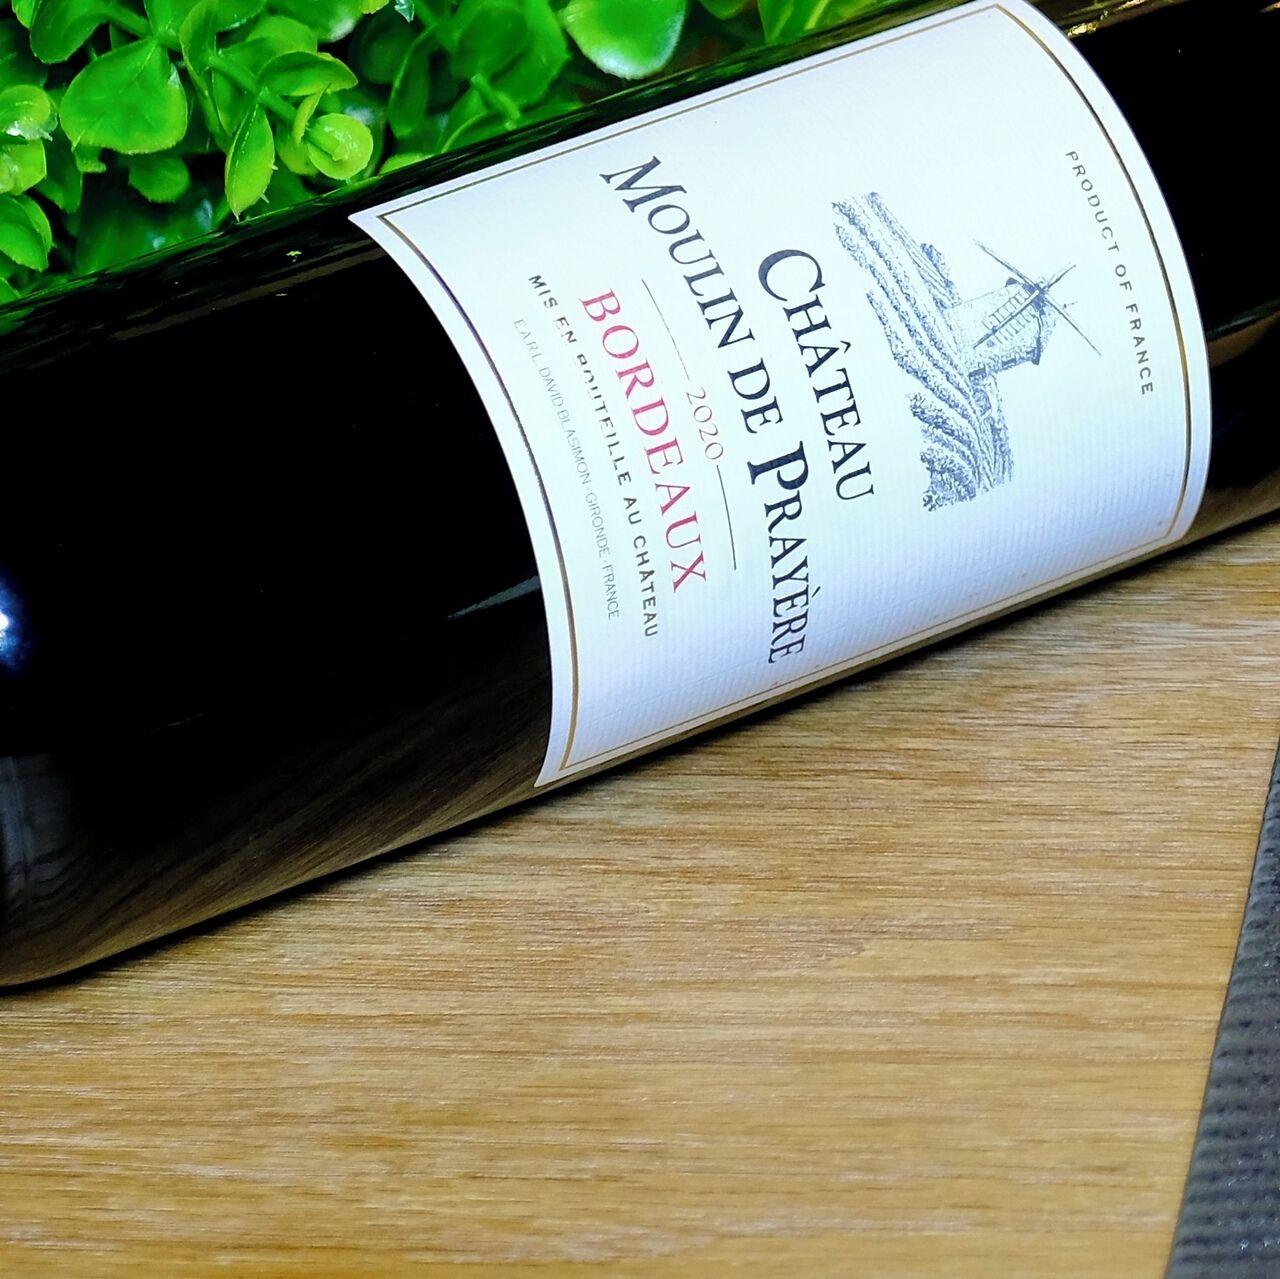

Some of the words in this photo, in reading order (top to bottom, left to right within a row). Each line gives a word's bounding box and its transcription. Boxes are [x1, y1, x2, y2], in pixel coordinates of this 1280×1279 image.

[599, 155, 756, 349] MOULIN
[757, 248, 875, 501] CHÂTEAU
[1065, 150, 1120, 253] PRODUCT
[1114, 263, 1133, 292] OF
[1125, 303, 1154, 396] FRANCE
[528, 274, 559, 309] MIS
[553, 316, 578, 345] EN
[623, 496, 643, 525] AU
[633, 535, 659, 637] CHÂTEAU
[538, 366, 565, 409] DAVID
[556, 409, 592, 486] BLASIMON
[584, 491, 611, 559] GIRONDE
[601, 563, 621, 621] FRANCE
[578, 288, 707, 593] BORDEAUX
[686, 386, 724, 460] 2020
[727, 357, 784, 434] DE
[747, 440, 822, 664] PRAYÈRE
